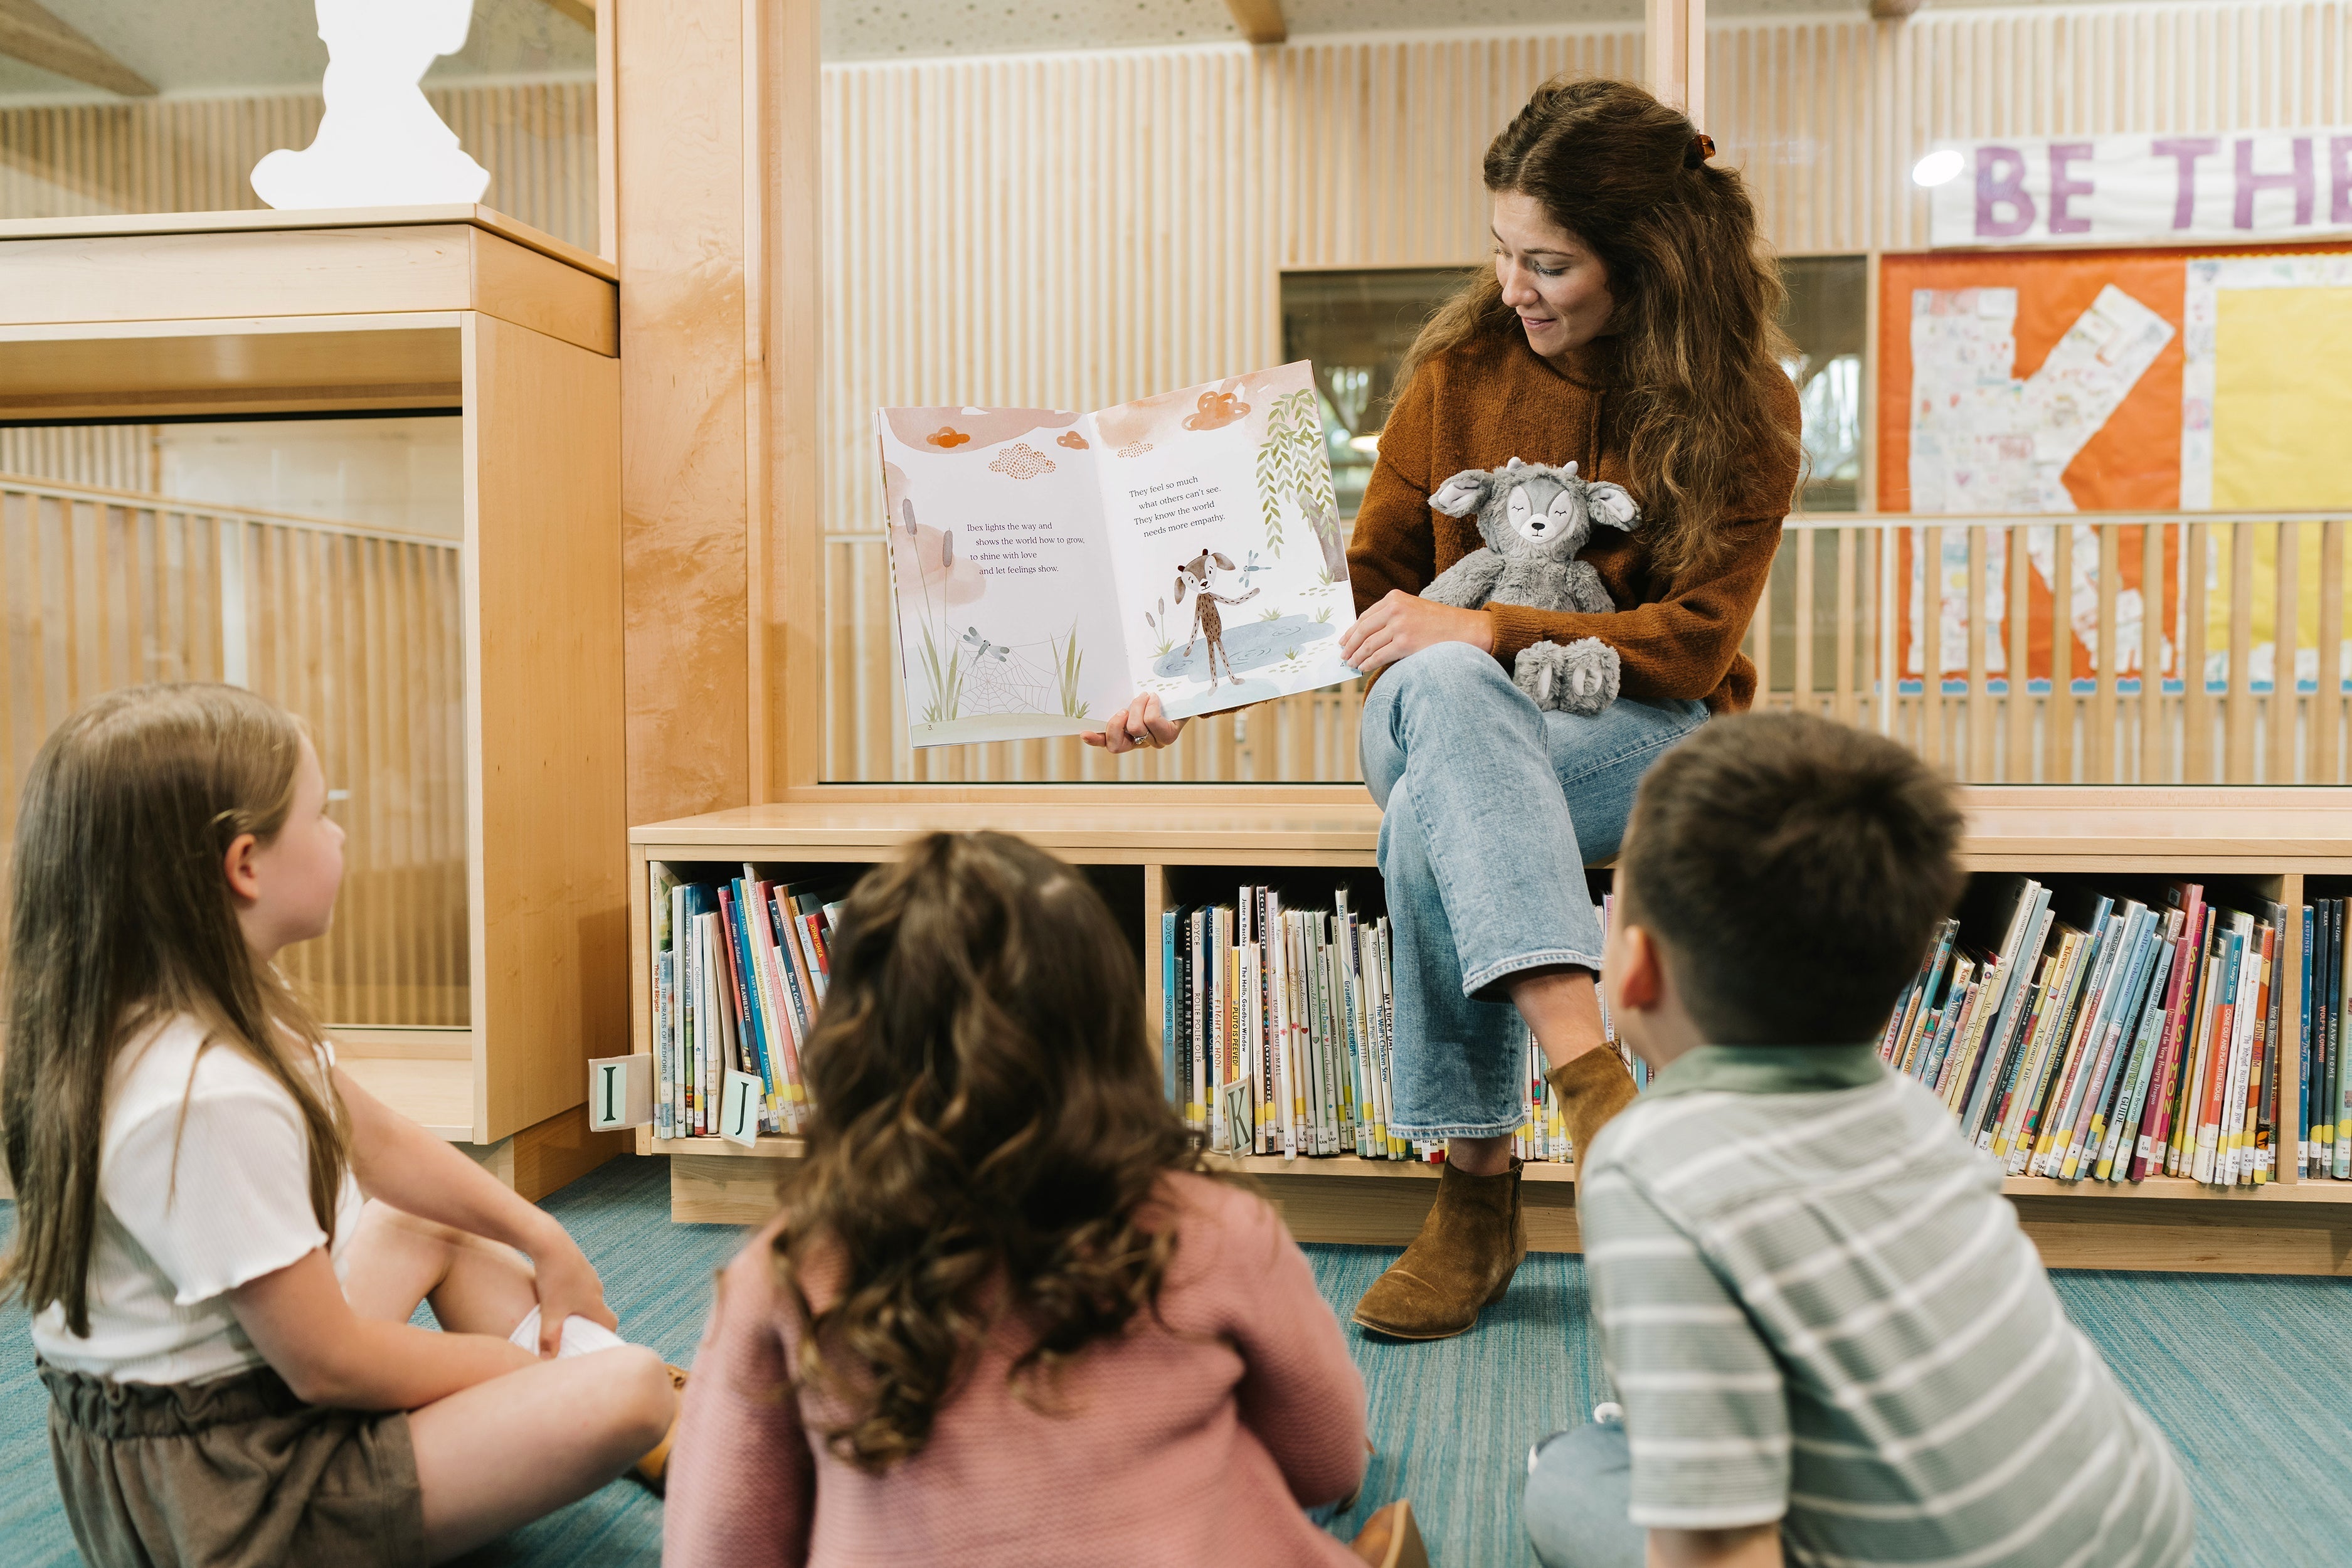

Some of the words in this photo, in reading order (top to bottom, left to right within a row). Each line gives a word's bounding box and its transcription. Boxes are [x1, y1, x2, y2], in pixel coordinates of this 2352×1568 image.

[1974, 144, 2095, 237] BE
[1129, 489, 1148, 497] They
[1150, 484, 1163, 492] feel
[1177, 476, 1198, 487] much
[1139, 501, 1157, 509] what
[1160, 494, 1184, 504] others
[1185, 489, 1204, 499] can't
[1134, 516, 1153, 525] They
[1155, 511, 1176, 520] know
[1192, 501, 1214, 511] world
[985, 524, 1005, 532] lights
[1143, 527, 1166, 537] needs
[1168, 522, 1188, 532] more
[1190, 514, 1225, 526] empathy.
[1007, 566, 1036, 575] feelings
[2195, 913, 2205, 933] Knall
[2277, 918, 2286, 941] Krosoczka
[1936, 950, 1947, 972] KIRK
[2058, 946, 2072, 969] Kleven
[2161, 964, 2169, 975] The
[2180, 946, 2198, 1015] SICK
[1966, 991, 1976, 1005] KIRK
[2151, 978, 2165, 1002] Younger
[2227, 985, 2235, 1000] Dewey
[763, 1004, 771, 1030] ROBOMOM
[2143, 1004, 2157, 1032] Brother's
[2223, 1008, 2232, 1026] COME
[2270, 1005, 2279, 1019] Annie
[661, 1031, 667, 1041] OF
[2268, 1030, 2276, 1047] Warned
[1359, 1029, 1367, 1068] MIGHTIEST
[1946, 1043, 1958, 1065] SNOW
[2028, 1036, 2042, 1065] Carousel
[764, 1058, 773, 1093] CANDLEWICK
[2023, 1067, 2032, 1082] Tale
[2124, 1039, 2148, 1091] SURVIVAL
[2163, 1024, 2185, 1115] SIMON
[1938, 1067, 1949, 1093] FAMILY
[2213, 1082, 2222, 1101] MOUSE
[603, 1066, 616, 1121] I
[735, 1081, 749, 1136] J
[1228, 1086, 1250, 1150] K
[2114, 1096, 2129, 1126] GUIDE
[2205, 1150, 2213, 1177] Greenwillow
